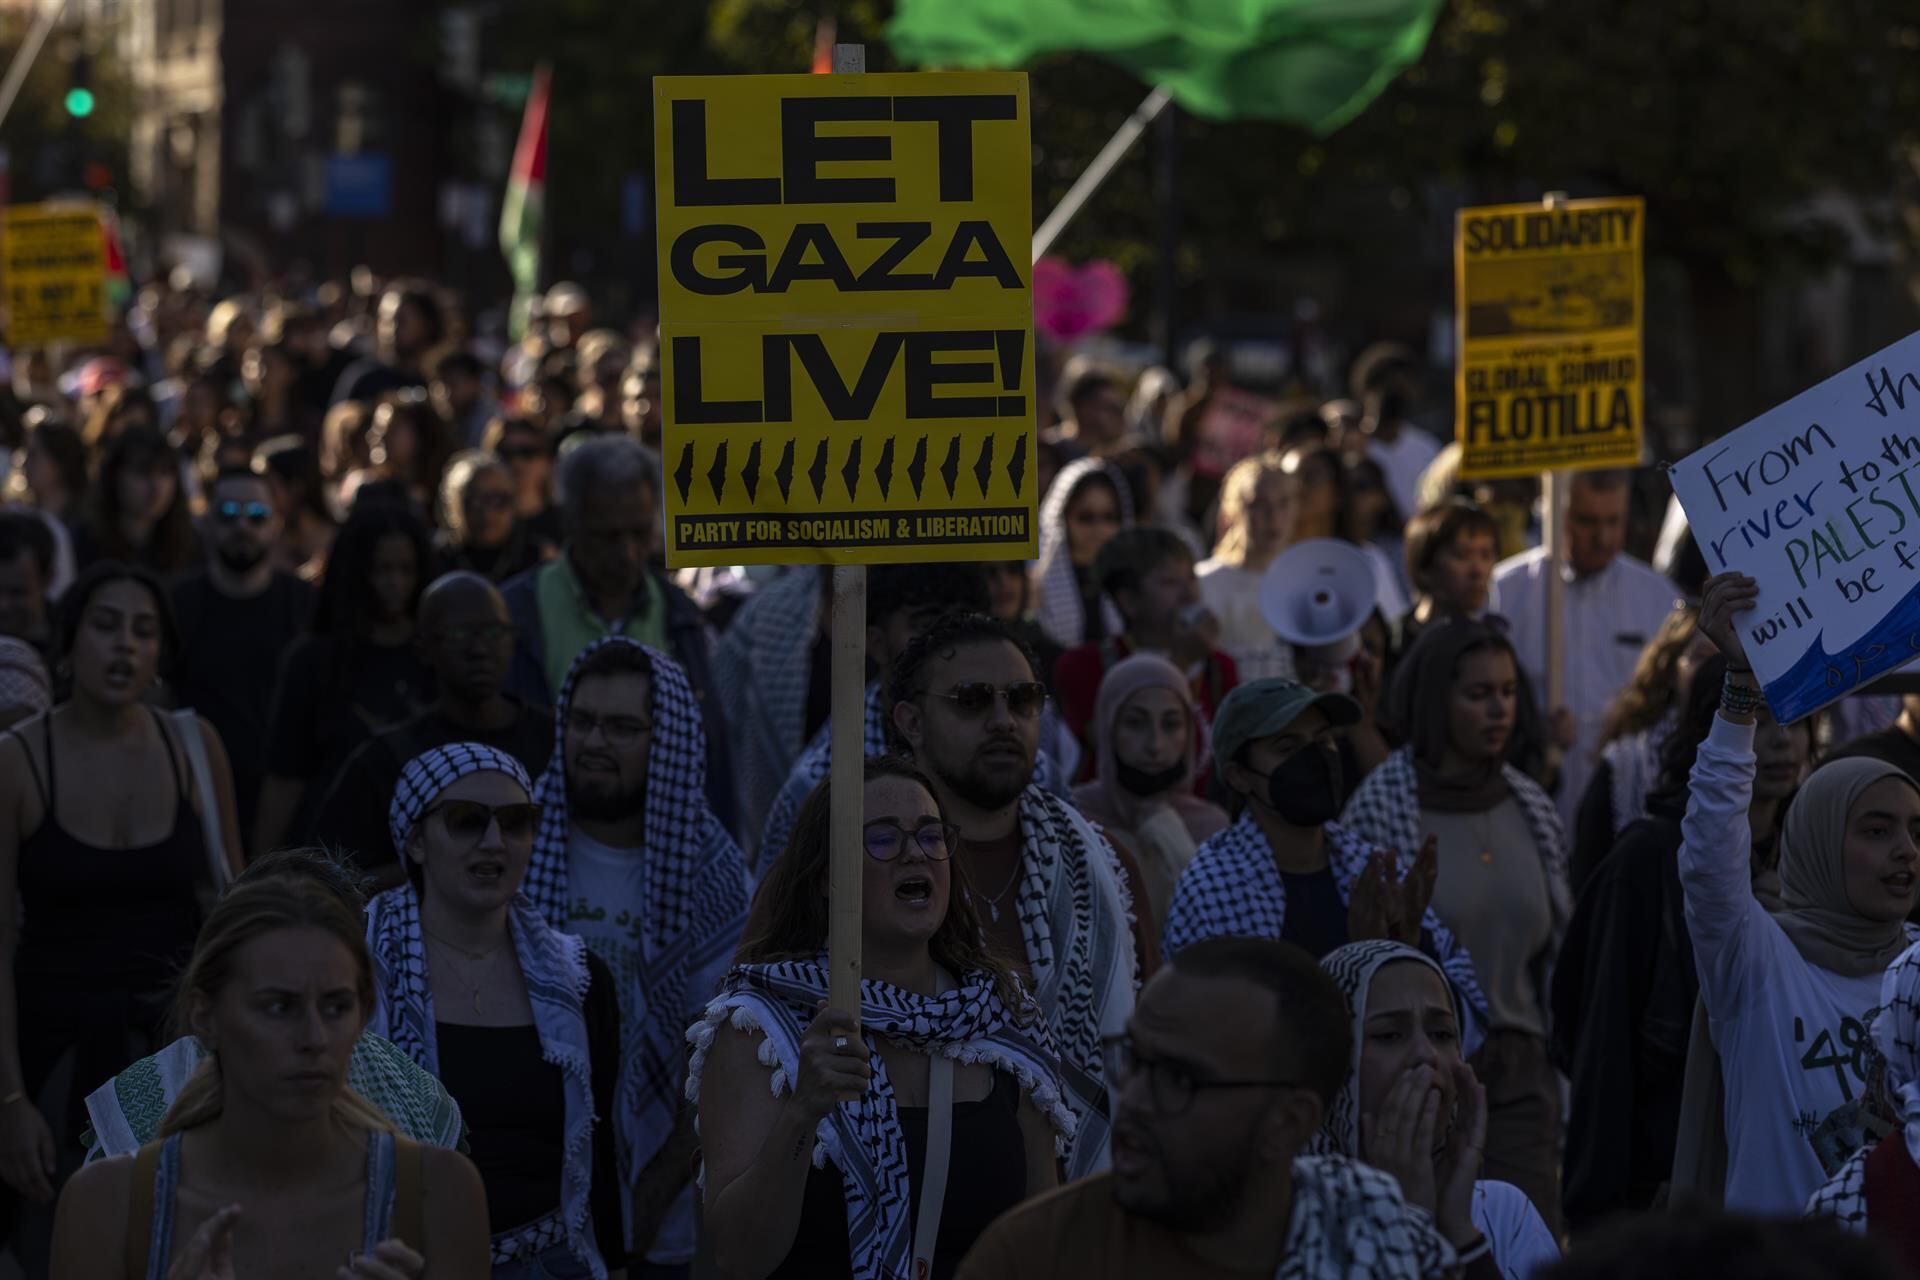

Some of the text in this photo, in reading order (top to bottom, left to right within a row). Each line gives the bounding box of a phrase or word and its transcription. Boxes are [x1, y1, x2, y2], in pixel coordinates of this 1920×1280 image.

[671, 94, 1018, 206] LET
[669, 220, 1025, 295] GAZA
[1467, 207, 1636, 254] SOLIDARITY
[672, 330, 1027, 424] LIVE!
[1468, 388, 1633, 444] FLOTILLA
[1702, 424, 1836, 512] From
[680, 514, 1025, 544] PARTY FOR SOCIALISM & LIBERATION
[1710, 481, 1823, 568] river
[1840, 460, 1881, 493] to
[1752, 597, 1813, 645] will
[1835, 567, 1885, 603] be
